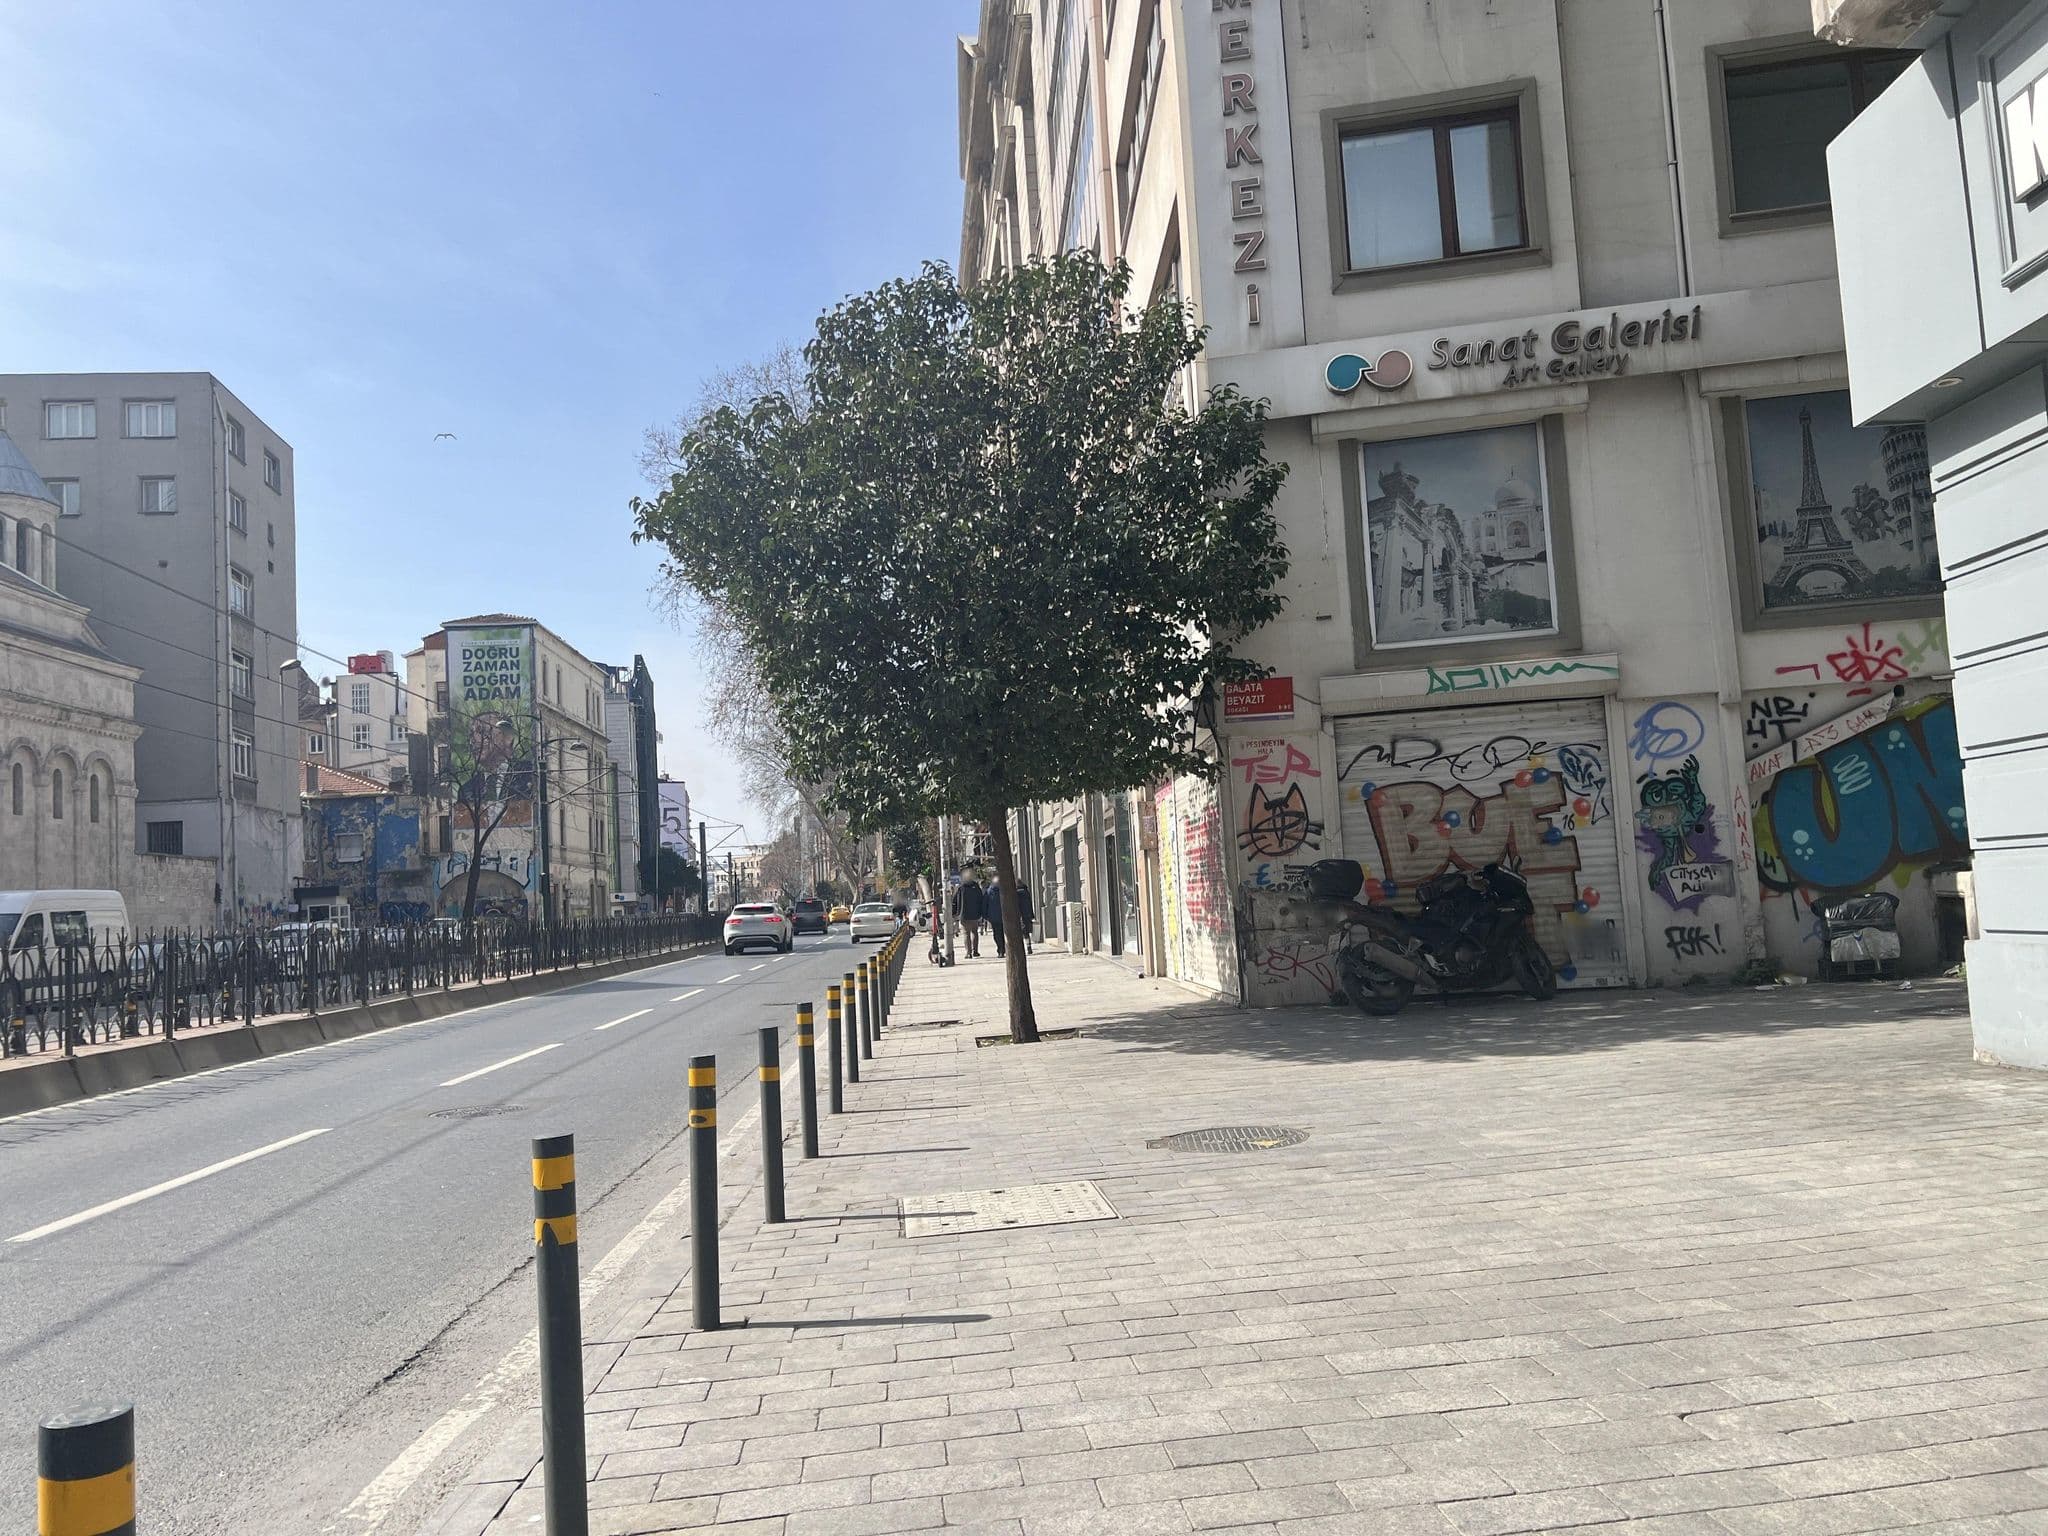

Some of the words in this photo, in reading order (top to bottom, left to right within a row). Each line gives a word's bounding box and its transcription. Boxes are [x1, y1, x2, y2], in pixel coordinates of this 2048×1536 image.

[1211, 0, 1267, 324] ERKEZİ
[1428, 328, 1539, 370] Sanat
[1551, 305, 1703, 354] Galerisi
[1503, 363, 1540, 387] Art
[1545, 351, 1631, 380] Gallery
[462, 646, 520, 660] DOĞRU
[463, 660, 520, 672] ZAMAN
[463, 673, 520, 687] DOĞRU
[464, 686, 521, 700] ADAM
[1226, 682, 1263, 694] GALATA
[1227, 694, 1266, 706] BEYAZIT
